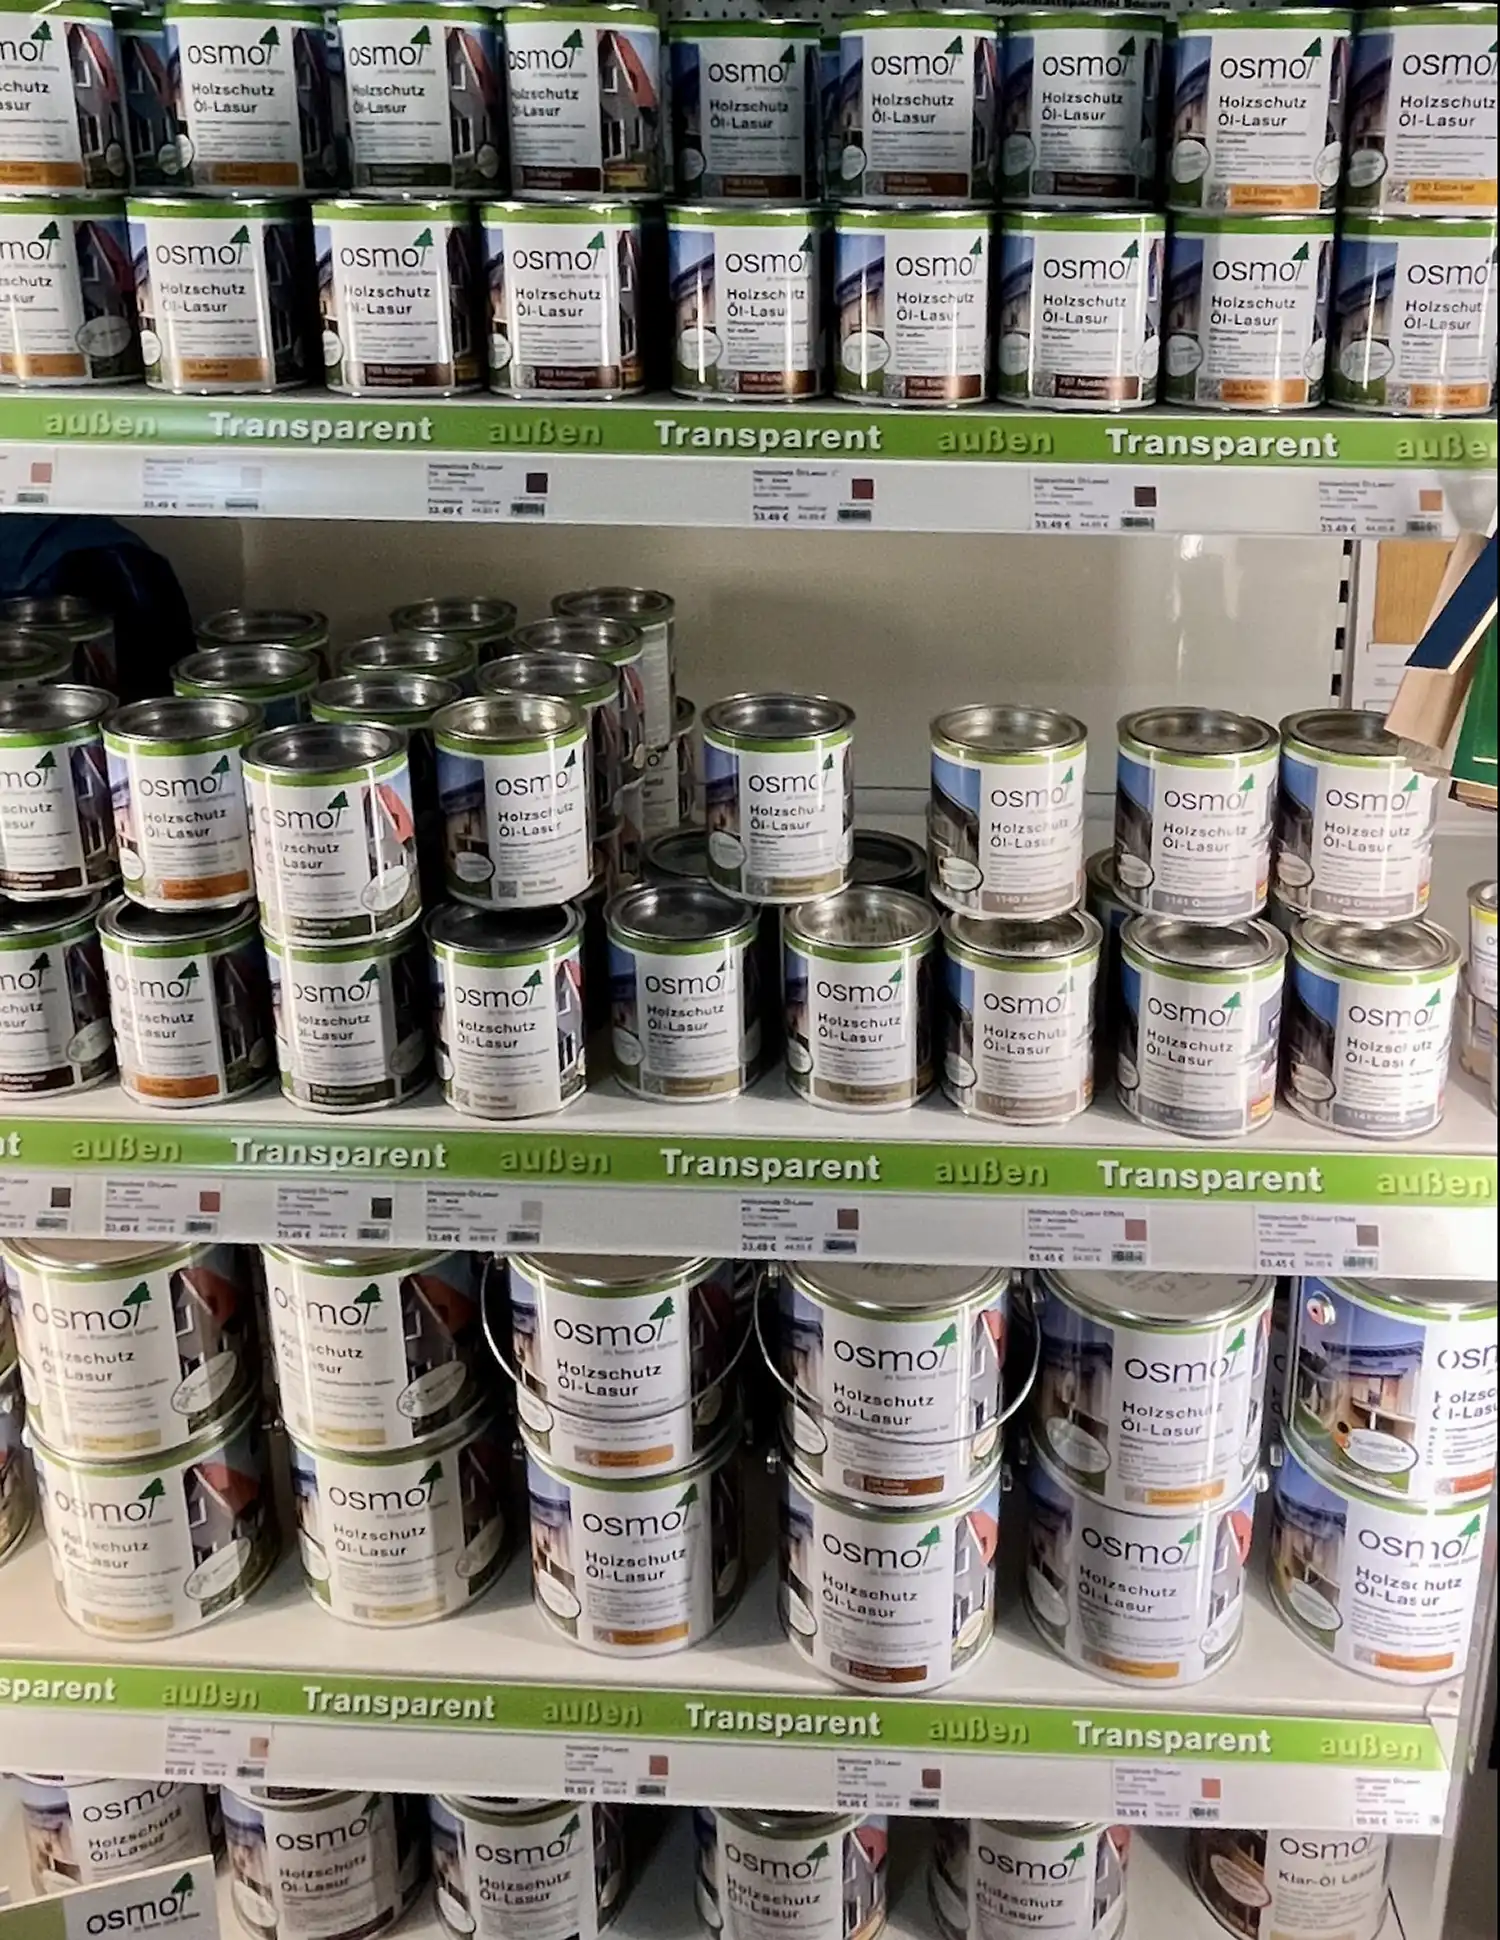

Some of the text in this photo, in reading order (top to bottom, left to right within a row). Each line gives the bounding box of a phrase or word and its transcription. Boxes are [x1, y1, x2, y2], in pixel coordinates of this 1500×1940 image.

[188, 44, 263, 66] osmo
[871, 54, 949, 76] osmo
[1042, 54, 1122, 77] osmo
[1402, 54, 1492, 77] osmo
[708, 62, 783, 83] osmo
[1220, 56, 1310, 80] osmo
[192, 83, 275, 97] Holzschutz
[871, 93, 954, 107] Holzschutz
[1042, 92, 1123, 105] Holzschutz
[194, 100, 257, 115] Öl-Lasur
[710, 99, 789, 113] Holzschutz
[1218, 95, 1307, 110] Holzschutz
[1400, 95, 1496, 110] Holzschutz
[710, 116, 773, 130] Öl-Lasur
[872, 109, 936, 125] Öl-Lasur
[1042, 107, 1106, 122] Öl-Lasur
[1218, 112, 1287, 128] Öl-Lasur
[1399, 112, 1476, 128] Öl-Lasur
[156, 245, 236, 265] osmo
[340, 247, 420, 268] osmo
[513, 250, 591, 270] osmo
[725, 253, 803, 273] osmo
[896, 256, 972, 277] osmo
[1043, 258, 1124, 280] osmo
[1212, 260, 1296, 282] osmo
[516, 288, 601, 301] Holzschutz
[1043, 295, 1127, 309] Holzschutz
[1211, 296, 1297, 311] Holzschutz
[516, 303, 584, 318] Öl-Lasur
[1042, 312, 1109, 325] Öl-Lasur
[1210, 313, 1280, 327] Öl-Lasur
[45, 412, 158, 437] außen
[208, 411, 433, 443] Transparent
[489, 418, 603, 446] außen
[653, 419, 882, 452] Transparent
[938, 426, 1054, 454] außen
[1105, 427, 1341, 461] Transparent
[140, 776, 216, 798] osmo
[751, 816, 810, 830] Öl-Lasur
[645, 973, 720, 995] osmo
[817, 981, 892, 1002] osmo
[455, 986, 528, 1007] osmo
[984, 993, 1060, 1015] osmo
[647, 1004, 724, 1019] Holzschutz
[818, 1012, 900, 1029] Holzschutz
[1148, 997, 1227, 1027] osmo
[647, 1019, 709, 1031] Öl-Lasur
[818, 1027, 883, 1043] Öl-Lasur
[983, 1039, 1050, 1055] Öl-Lasur
[1147, 1029, 1233, 1053] Holzschutz
[1147, 1043, 1213, 1067] Öl-Lasur
[72, 1134, 181, 1162] außen
[231, 1137, 449, 1172] Transparent
[501, 1149, 611, 1174] außen
[660, 1147, 881, 1183] Transparent
[935, 1159, 1048, 1187] außen
[1097, 1160, 1325, 1195] Transparent
[1376, 1170, 1492, 1198] außen
[554, 1319, 655, 1346] osmo
[834, 1339, 938, 1372] osmo
[557, 1359, 662, 1381] Holzschutz
[558, 1377, 638, 1397] Öl-Lasur
[833, 1382, 934, 1408] Holzschutz
[833, 1401, 912, 1426] Öl-Lasur
[1122, 1418, 1203, 1437] Öl-Lasur
[329, 1486, 425, 1511] osmo
[583, 1511, 682, 1537] osmo
[336, 1540, 408, 1558] Öl-Lasur
[823, 1534, 922, 1569] osmo
[1082, 1527, 1184, 1565] osmo
[585, 1547, 686, 1568] Holzschutz
[586, 1566, 666, 1582] Öl-Lasur
[1079, 1565, 1177, 1597] Holzschutz
[823, 1572, 918, 1602] Holzschutz
[1078, 1581, 1155, 1614] Öl-Lasur
[823, 1590, 897, 1618] Öl-Lasur
[162, 1682, 259, 1709] außen
[303, 1685, 496, 1721] Transparent
[542, 1699, 642, 1728] außen
[686, 1703, 882, 1738] Transparent
[928, 1712, 1029, 1745] außen
[1072, 1719, 1272, 1755] Transparent
[1320, 1732, 1422, 1762] außen
[276, 1818, 367, 1851] osmo
[475, 1842, 566, 1865] osmo
[1280, 1836, 1370, 1859] osmo
[725, 1842, 812, 1877] osmo
[978, 1845, 1068, 1880] osmo
[281, 1877, 349, 1893] Öl-Lasur
[479, 1870, 572, 1892] Holzschutz
[1278, 1868, 1337, 1887] Klar-Öl
[479, 1888, 551, 1905] Öl-Lasur
[727, 1874, 821, 1904] Holzschutz
[87, 1897, 178, 1935] osmo
